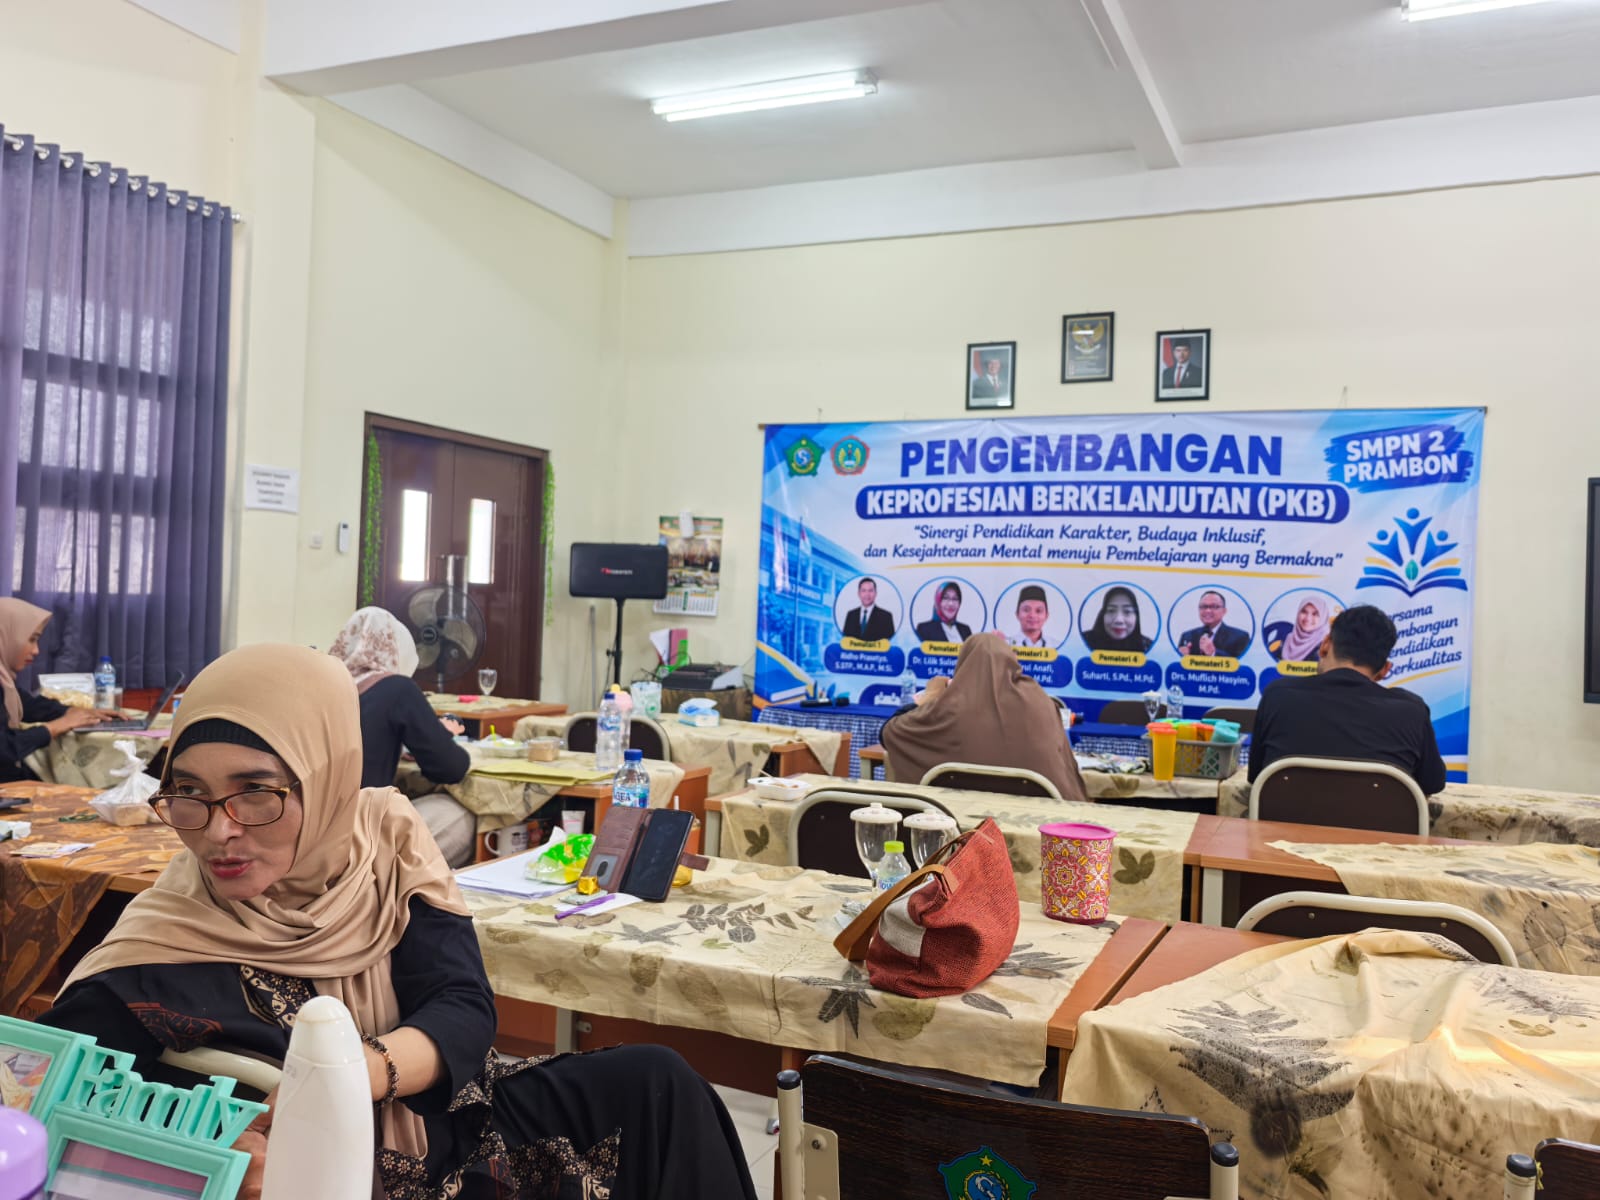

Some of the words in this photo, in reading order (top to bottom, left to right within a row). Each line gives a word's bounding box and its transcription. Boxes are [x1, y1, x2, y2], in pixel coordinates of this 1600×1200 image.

[900, 433, 1282, 477] PENGEMBANGAN
[1346, 433, 1421, 461] SMPN
[1428, 430, 1446, 452] 2
[1343, 454, 1458, 484] PRAMBON
[866, 485, 1026, 516] KEPROFESIAN
[1032, 484, 1250, 516] BERKELANJUTAN
[1257, 486, 1337, 521] (PKB)
[972, 524, 1054, 540] Pendidikan
[1059, 525, 1133, 543] Karakter,
[1137, 526, 1198, 546] Budaya
[1203, 527, 1266, 546] Inklusif,
[863, 544, 888, 558] dan
[892, 545, 987, 562] Kesejahteraan
[991, 545, 1042, 560] Mental
[1046, 547, 1102, 564] menuju
[1106, 546, 1208, 566] Pembelajaran
[1211, 552, 1250, 568] yang
[1388, 605, 1433, 622] rsama
[1397, 617, 1459, 638] mbangun
[929, 643, 958, 653] Pemateri
[1099, 653, 1131, 663] Pemateri
[1389, 636, 1454, 659] endidikan
[1190, 658, 1224, 668] Pemateri
[1286, 663, 1317, 673] Pemate
[1171, 671, 1187, 681] Drs.
[1218, 674, 1250, 686] Hasyim,
